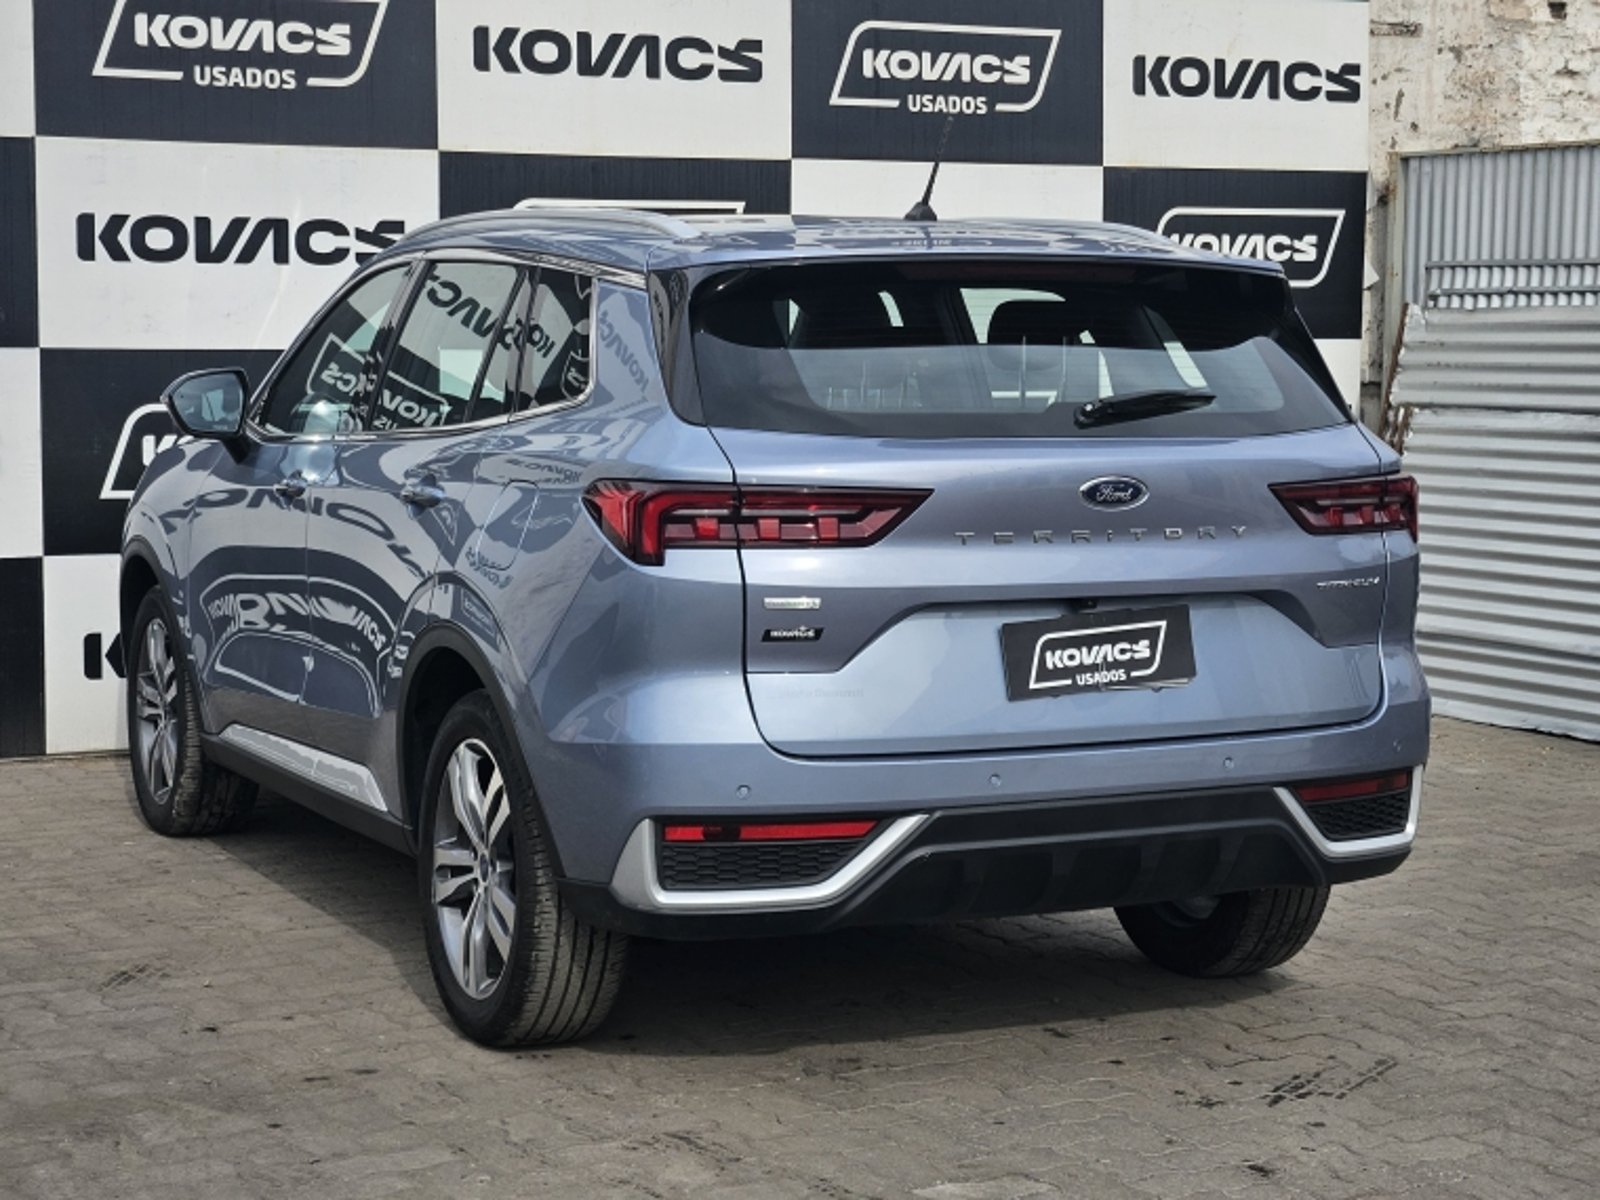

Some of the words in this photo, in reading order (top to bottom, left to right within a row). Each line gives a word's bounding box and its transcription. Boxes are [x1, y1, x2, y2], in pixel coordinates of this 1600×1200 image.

[133, 12, 351, 56] KOVACS
[473, 25, 763, 83] KOVACS
[862, 48, 1031, 85] KOVACS
[193, 65, 296, 89] USADOS
[1132, 54, 1361, 103] KOVACS
[907, 94, 988, 115] USADOS
[1096, 484, 1134, 501] Ford
[954, 525, 1247, 546] TERRITORY
[1045, 639, 1151, 670] KOVACS
[1075, 668, 1127, 686] USADOS
